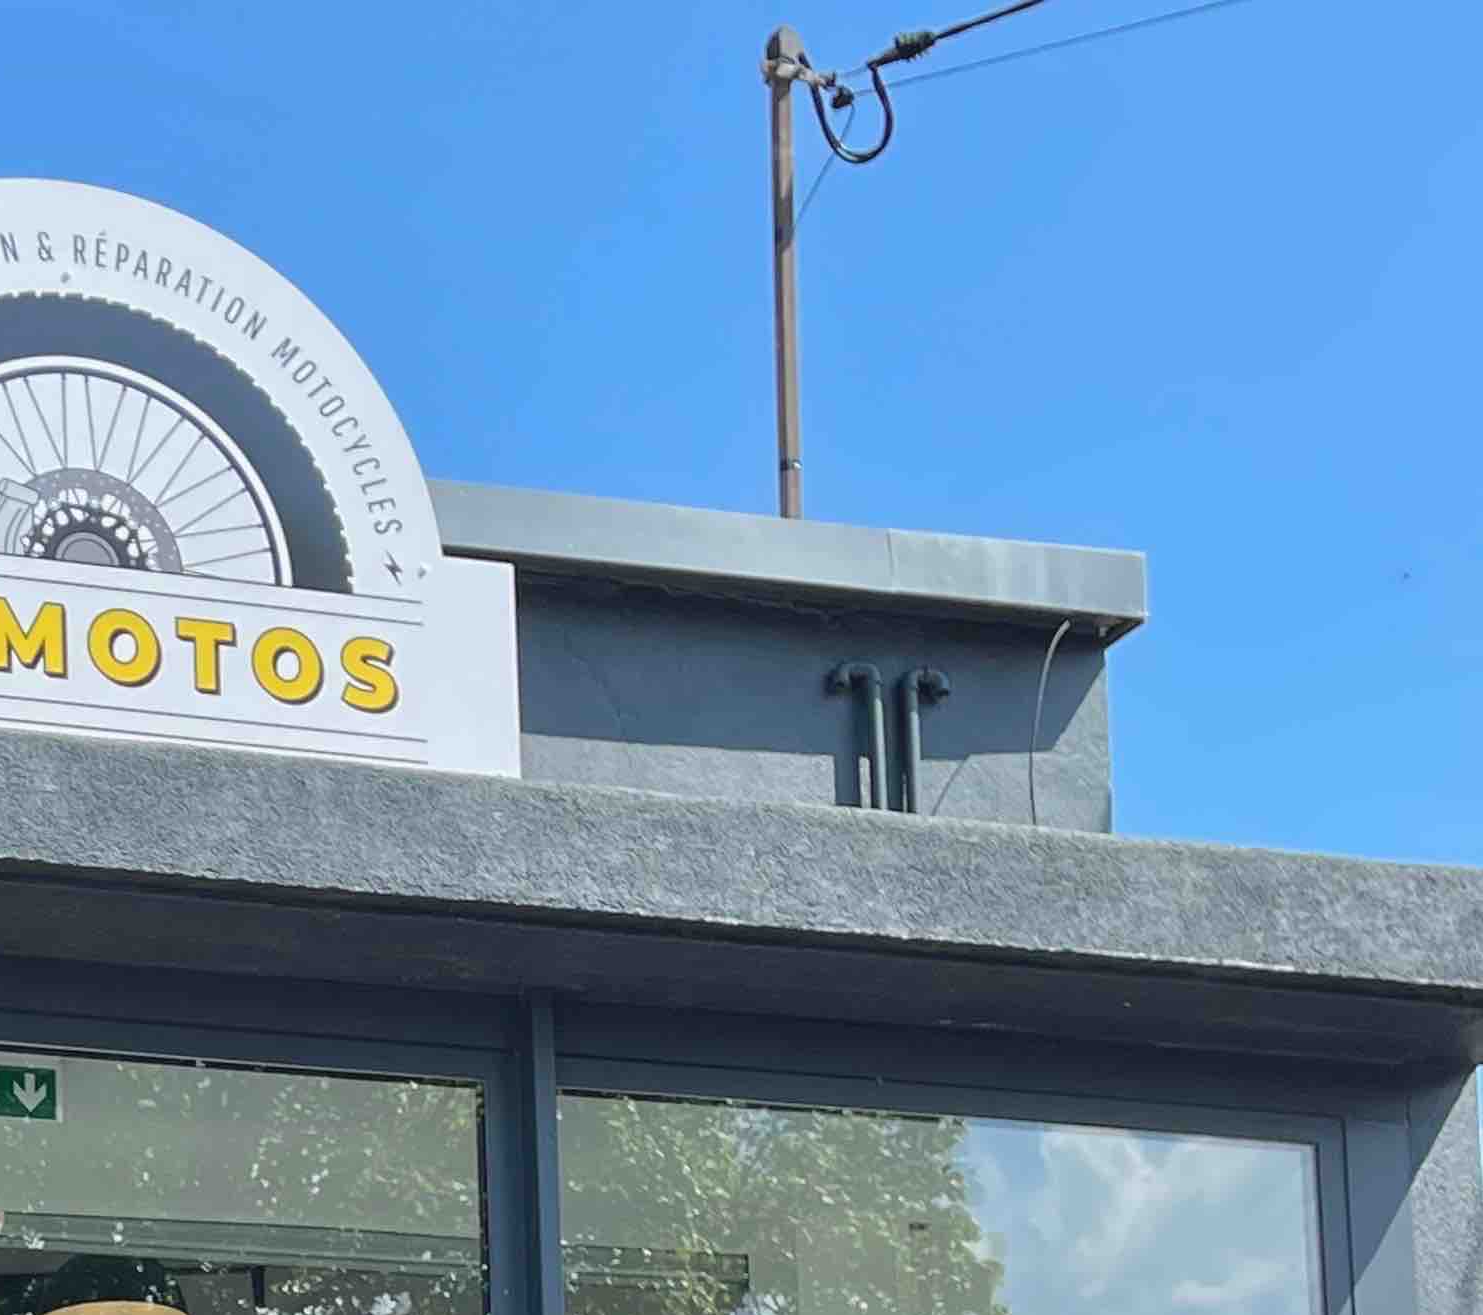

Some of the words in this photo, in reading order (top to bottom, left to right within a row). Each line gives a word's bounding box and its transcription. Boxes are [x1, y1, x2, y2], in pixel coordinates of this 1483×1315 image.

[36, 231, 56, 262] &
[72, 231, 268, 340] RÉPARATION
[271, 337, 403, 536] MOTOCYCLES
